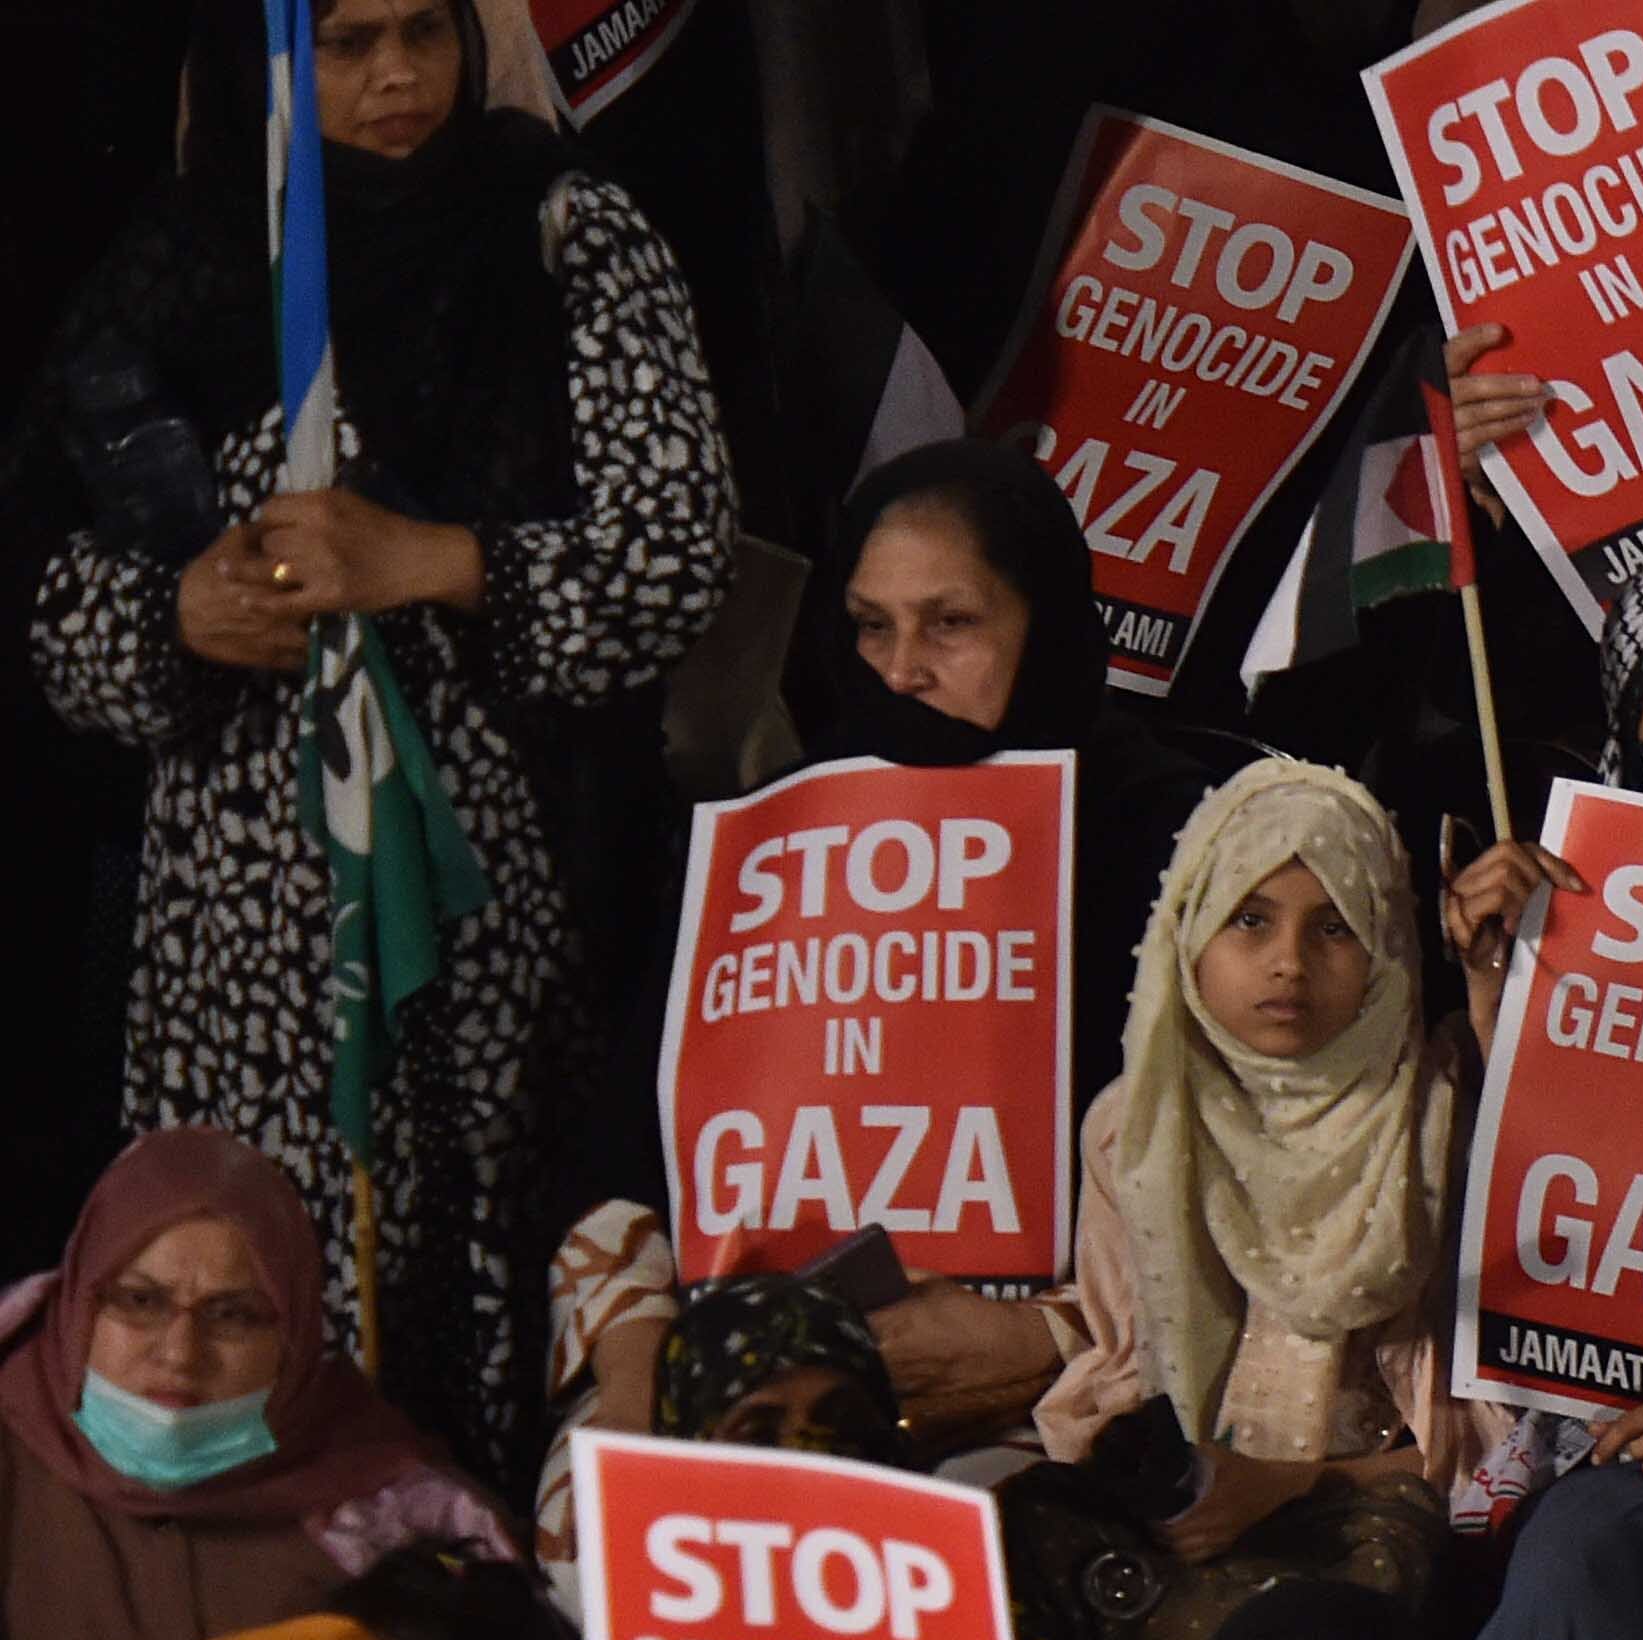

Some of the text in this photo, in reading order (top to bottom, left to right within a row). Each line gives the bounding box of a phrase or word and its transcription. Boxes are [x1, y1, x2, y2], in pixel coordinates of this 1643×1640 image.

[1102, 184, 1355, 324] STOP
[1056, 275, 1335, 411] GENOCIDE
[1123, 378, 1187, 429] IN
[1010, 421, 1221, 575] AZA
[729, 818, 1012, 933] STOP
[702, 930, 1036, 1023] GENOCIDE
[824, 1016, 883, 1076] IN
[693, 1105, 1021, 1236] GAZA
